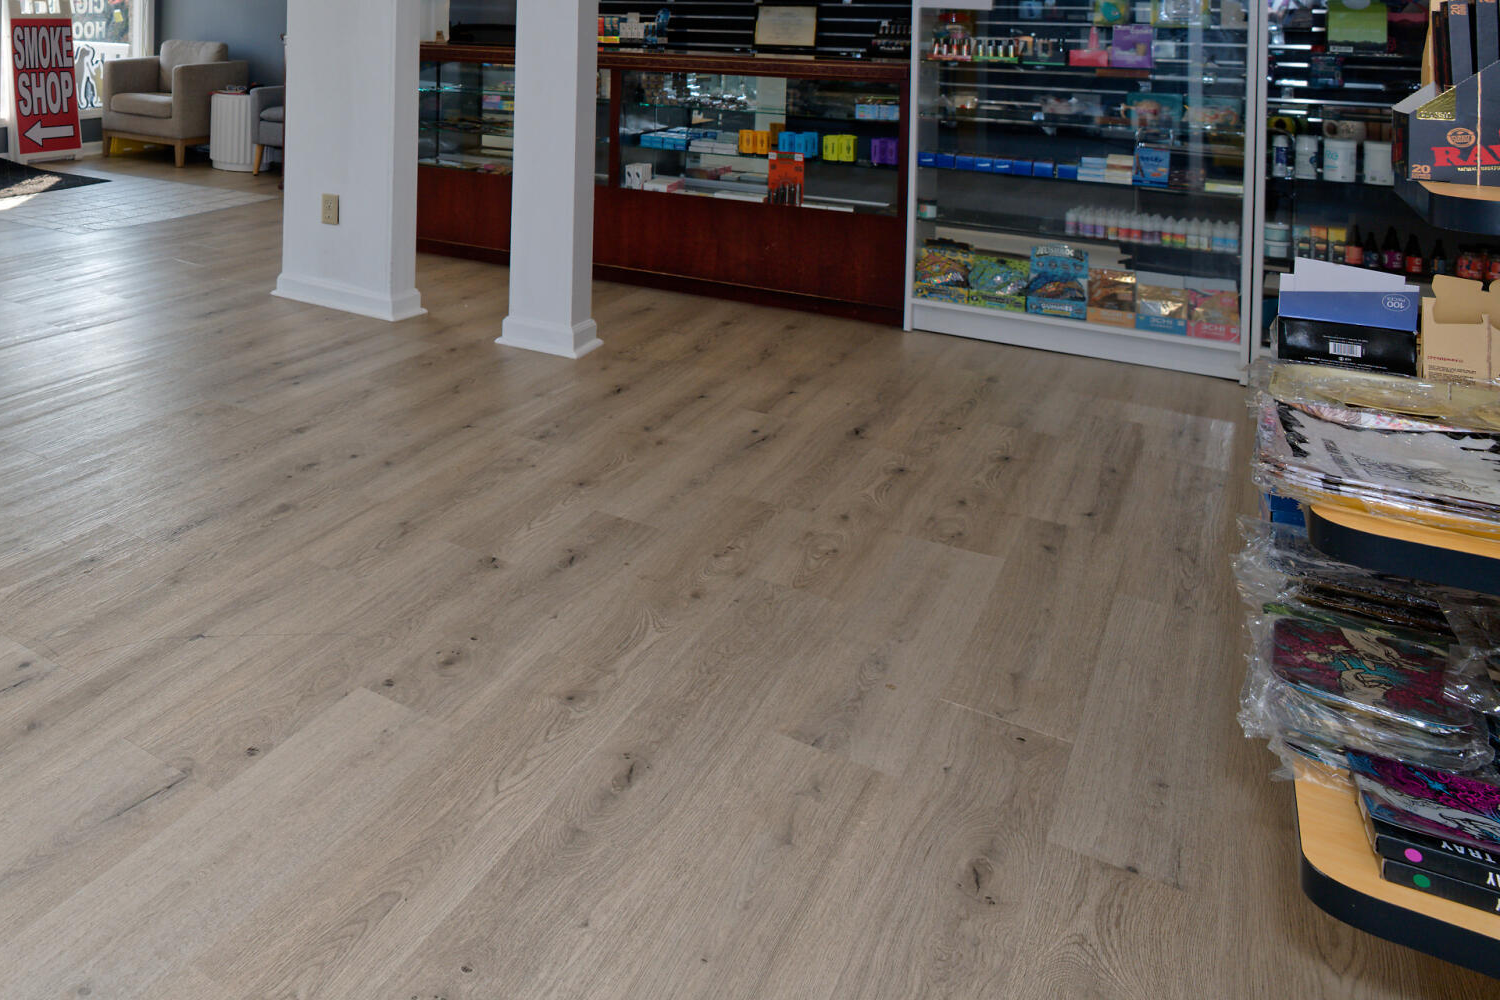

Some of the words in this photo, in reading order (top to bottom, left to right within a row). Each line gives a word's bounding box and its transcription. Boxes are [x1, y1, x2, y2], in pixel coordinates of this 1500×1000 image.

[13, 26, 74, 70] SMOKE
[18, 71, 73, 117] SHOP
[1431, 146, 1500, 167] RA
[1412, 164, 1430, 174] 20
[1386, 301, 1405, 309] 100
[1442, 841, 1496, 863] TRAY
